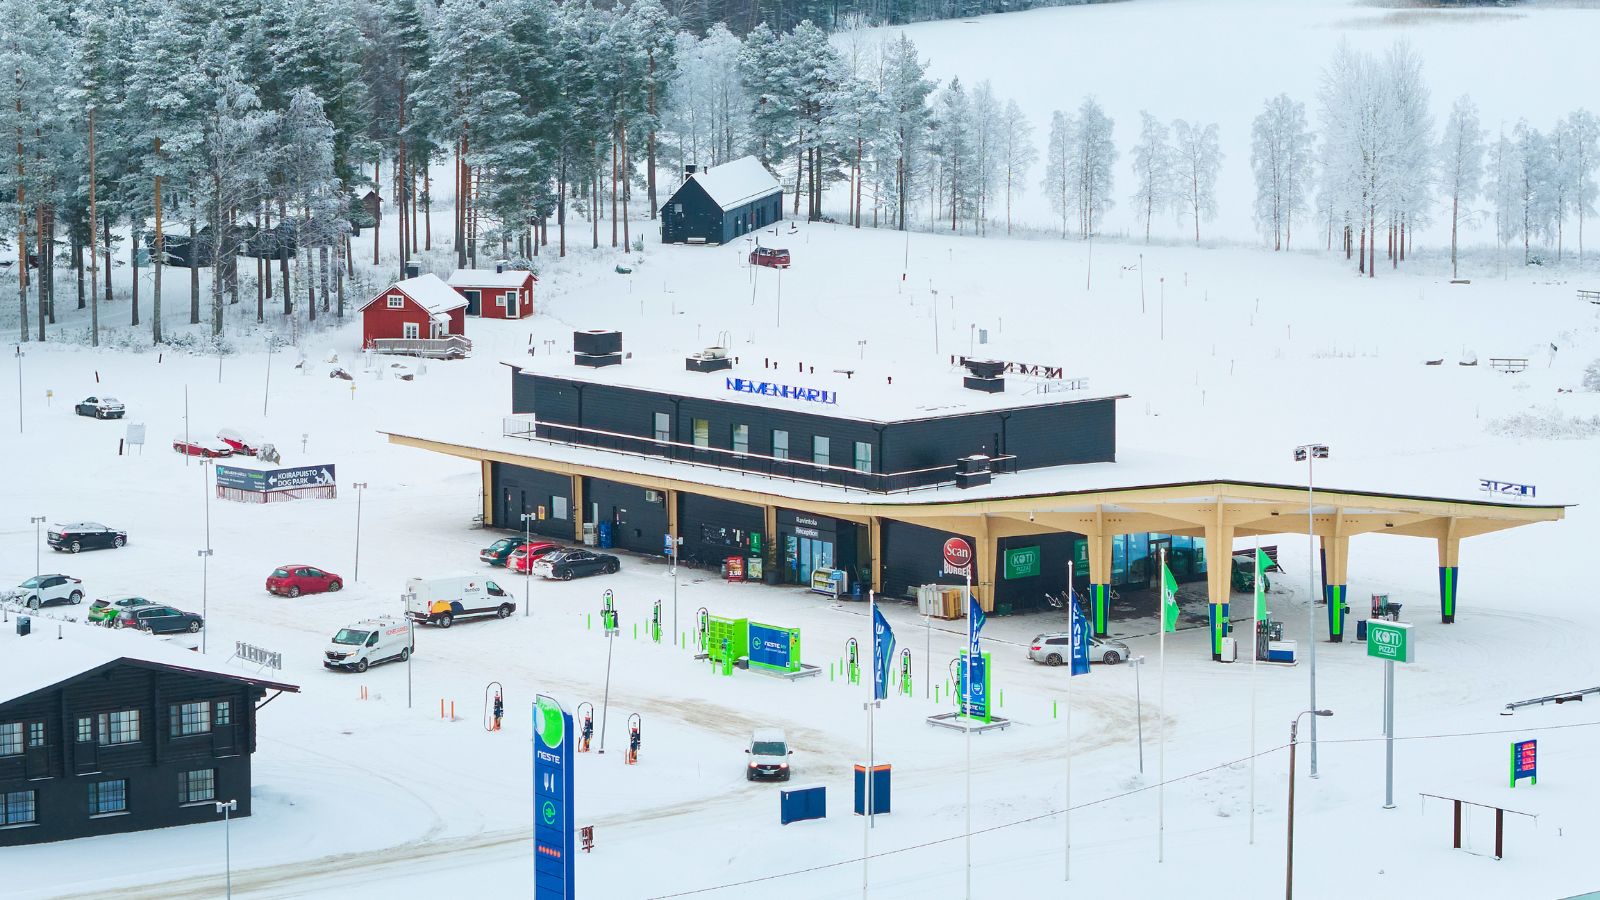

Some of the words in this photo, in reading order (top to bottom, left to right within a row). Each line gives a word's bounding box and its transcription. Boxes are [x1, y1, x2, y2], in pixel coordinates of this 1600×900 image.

[726, 377, 837, 404] NIEMENHARJU
[277, 470, 318, 480] KOIRAPUISTO
[278, 479, 292, 487] DOG
[293, 477, 309, 486] PARK
[796, 516, 818, 526] Ravintola
[796, 526, 819, 538] Reception
[947, 544, 968, 558] Scan
[1013, 554, 1033, 565] KOTI
[944, 558, 971, 577] BURGER
[1375, 630, 1399, 645] KOTI
[1379, 645, 1395, 654] PIZZA
[538, 750, 560, 764] NESTE
